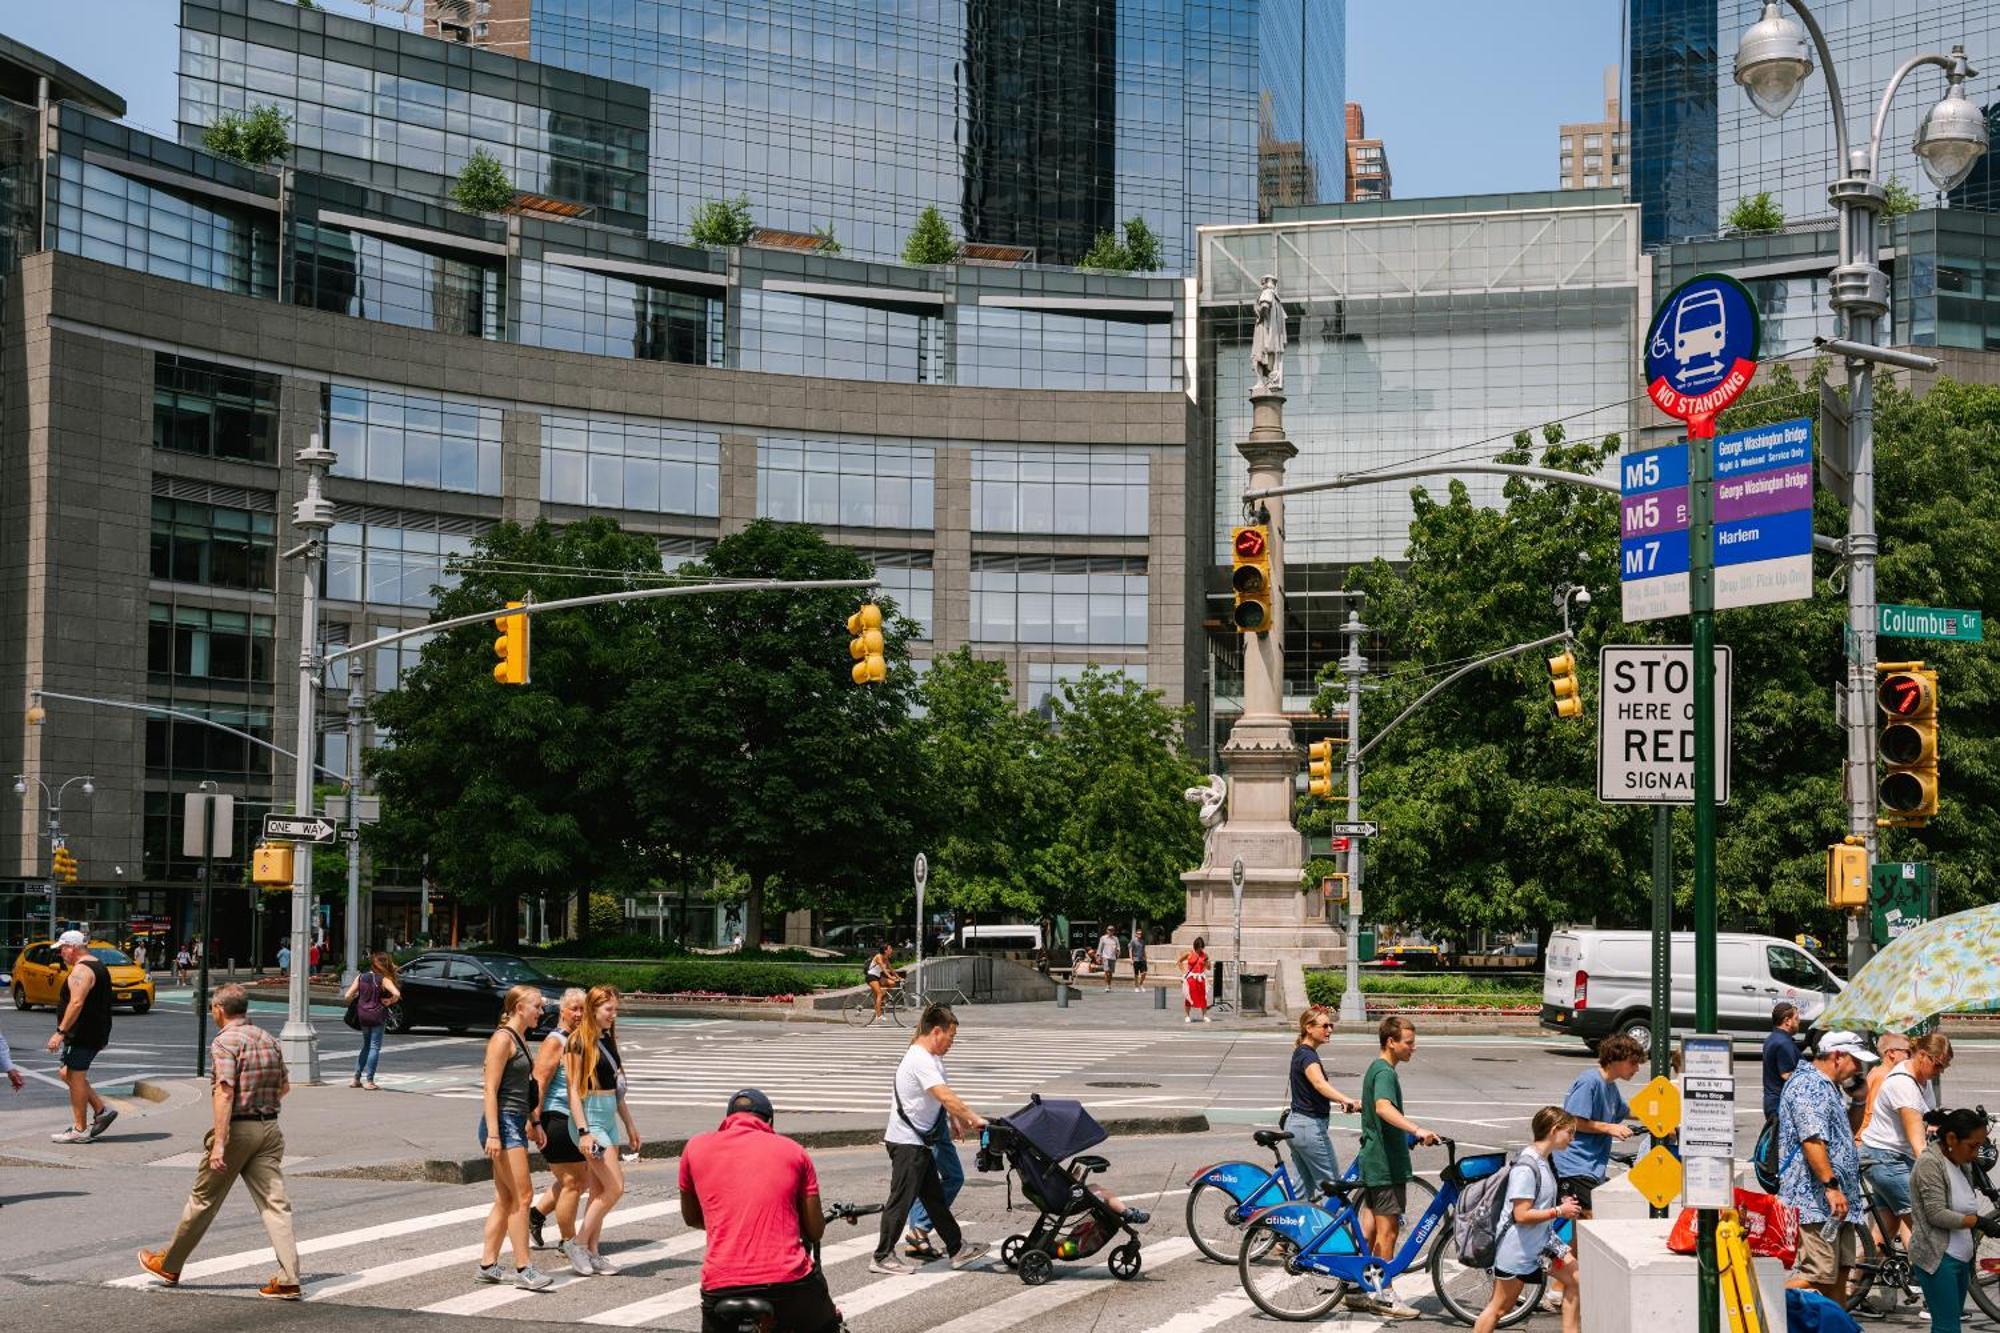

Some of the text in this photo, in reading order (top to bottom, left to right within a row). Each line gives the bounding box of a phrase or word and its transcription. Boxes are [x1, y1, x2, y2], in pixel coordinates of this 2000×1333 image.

[1655, 371, 1745, 414] NO STANDING
[1719, 426, 1808, 457] George Washington Bridge
[1768, 450, 1790, 462] Service
[1790, 448, 1804, 458] Only
[1626, 455, 1660, 489] M5
[1720, 471, 1808, 500] George Washington Bridge
[1626, 497, 1660, 531] M5
[1676, 504, 1686, 523] LTD
[1719, 528, 1760, 546] Harlem
[1626, 541, 1661, 574] M7
[1883, 609, 1947, 635] Columbu
[1962, 614, 1976, 628] Cir
[1614, 660, 1716, 694] STO
[1618, 703, 1672, 720] HERE
[270, 822, 326, 835] ONE WAY
[1709, 1092, 1724, 1100] Stop
[1222, 1174, 1238, 1183] bike
[1265, 1216, 1298, 1225] citi bike
